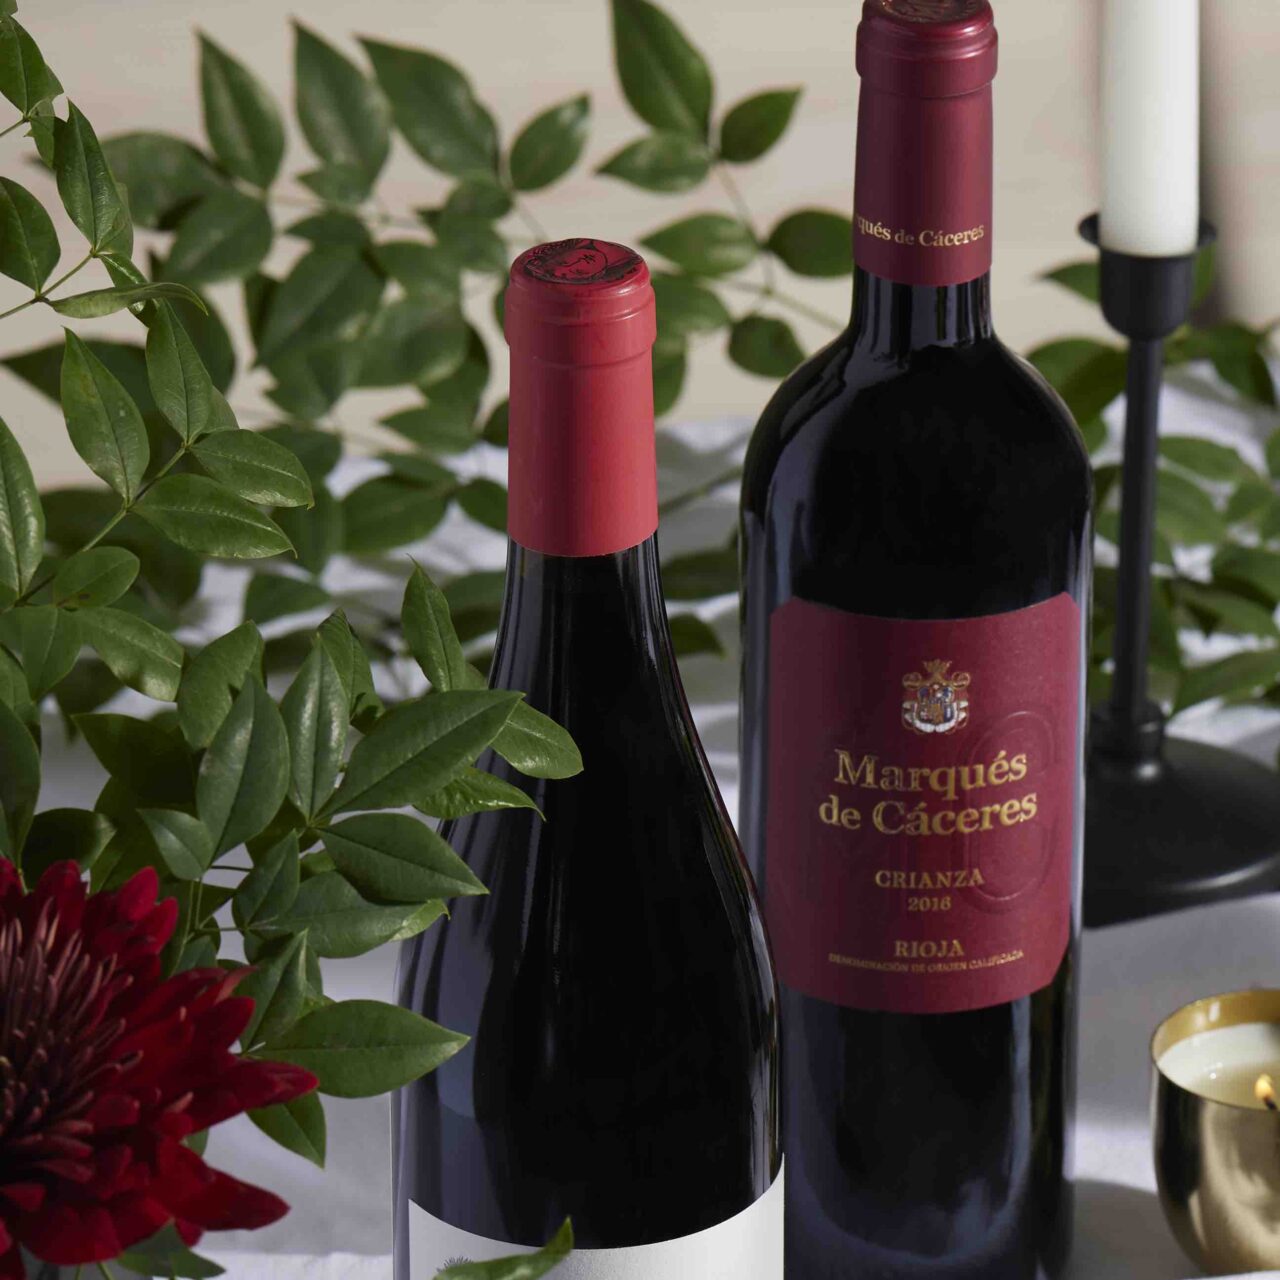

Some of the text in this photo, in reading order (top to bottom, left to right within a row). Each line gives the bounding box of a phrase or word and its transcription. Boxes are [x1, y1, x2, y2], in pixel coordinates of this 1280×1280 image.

[857, 214, 985, 247] qués de Cáceres
[834, 749, 1028, 800] Marqués
[819, 791, 1037, 836] de Cáceres
[875, 867, 985, 889] CRIANZA
[908, 896, 952, 912] 2016
[894, 939, 965, 958] RIOJA
